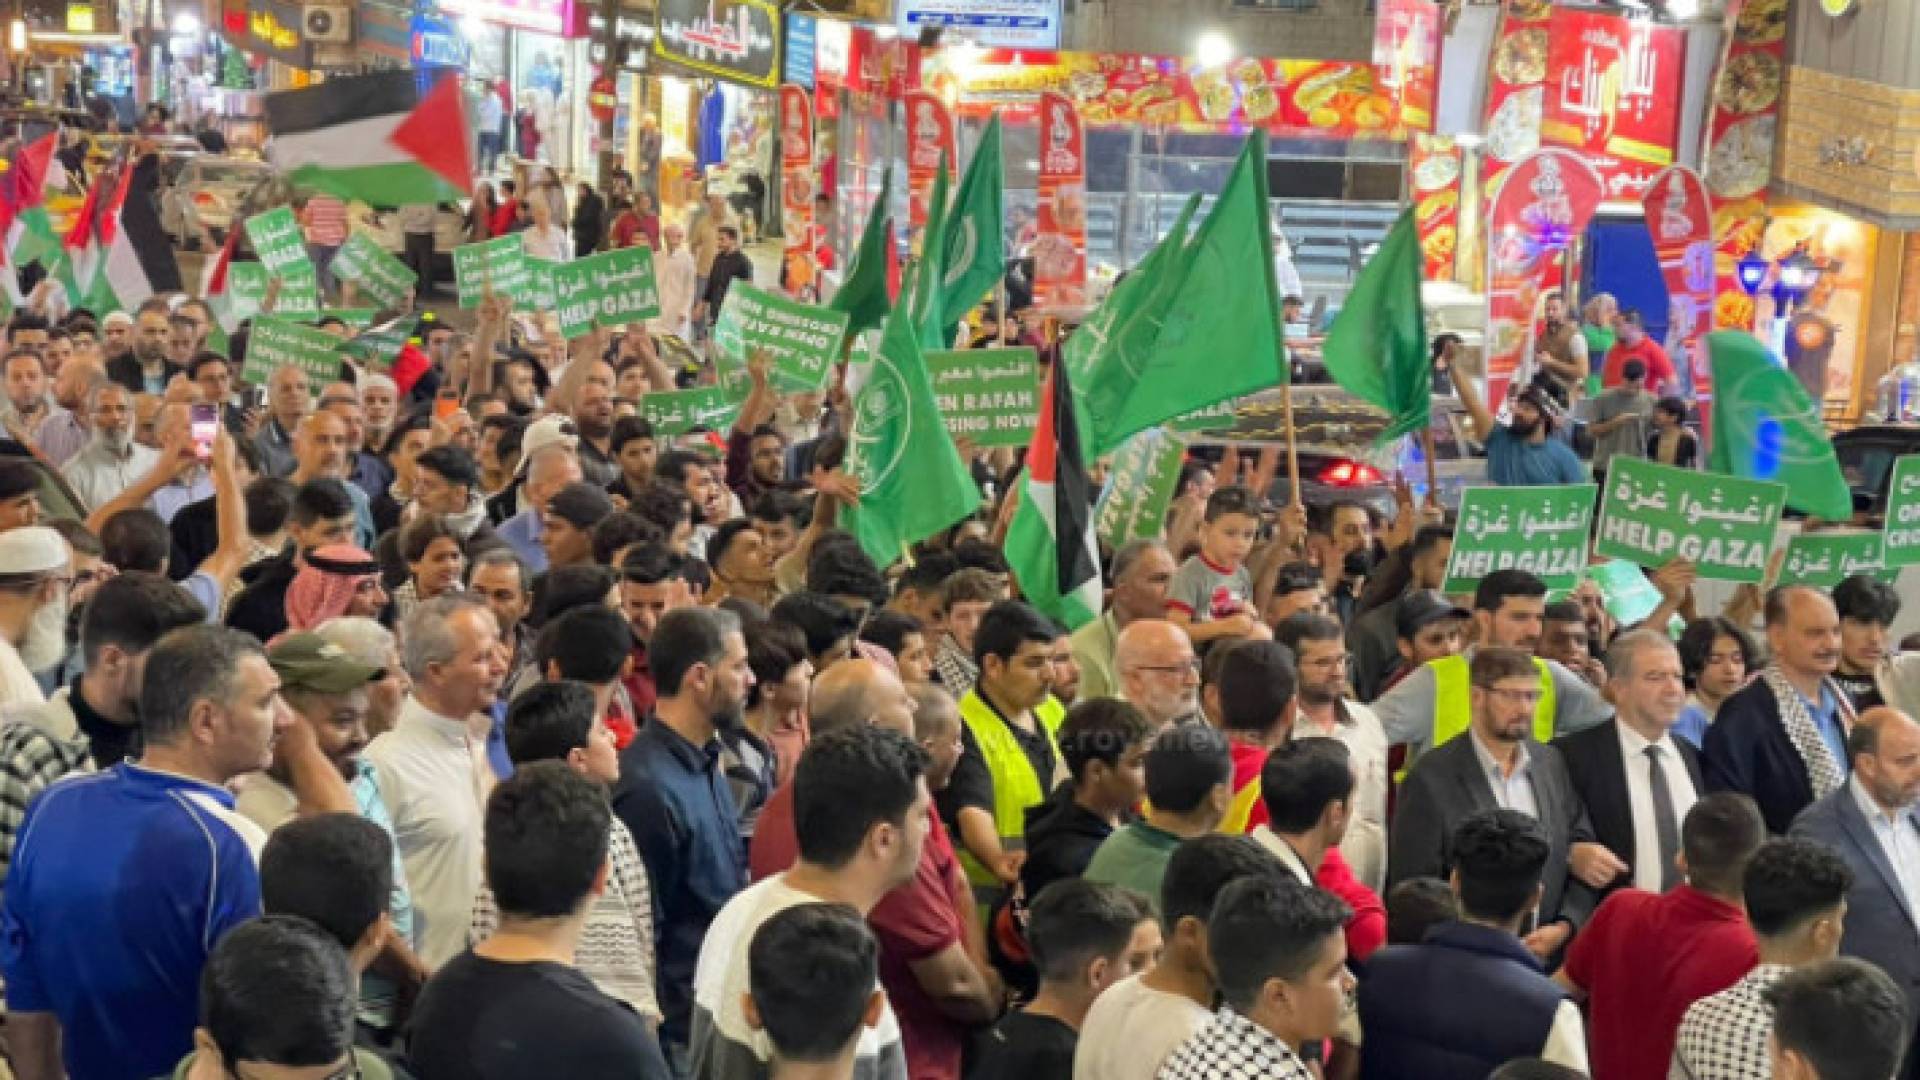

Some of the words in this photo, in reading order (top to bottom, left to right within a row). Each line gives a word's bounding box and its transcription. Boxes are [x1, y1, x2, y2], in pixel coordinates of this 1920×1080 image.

[560, 300, 600, 326] HELP
[602, 288, 657, 316] GAZA
[936, 393, 957, 411] EN
[963, 391, 1033, 411] RAFAH
[1615, 471, 1667, 512] غزة
[1679, 487, 1776, 532] اغيثوا
[1466, 504, 1510, 541] غزة
[1518, 499, 1589, 541] اغيثوا
[1604, 515, 1676, 556] HELP
[1679, 534, 1765, 569] GAZA
[1452, 549, 1514, 578] HELP
[1517, 547, 1578, 576] GAZA
[1787, 547, 1831, 579] غزة
